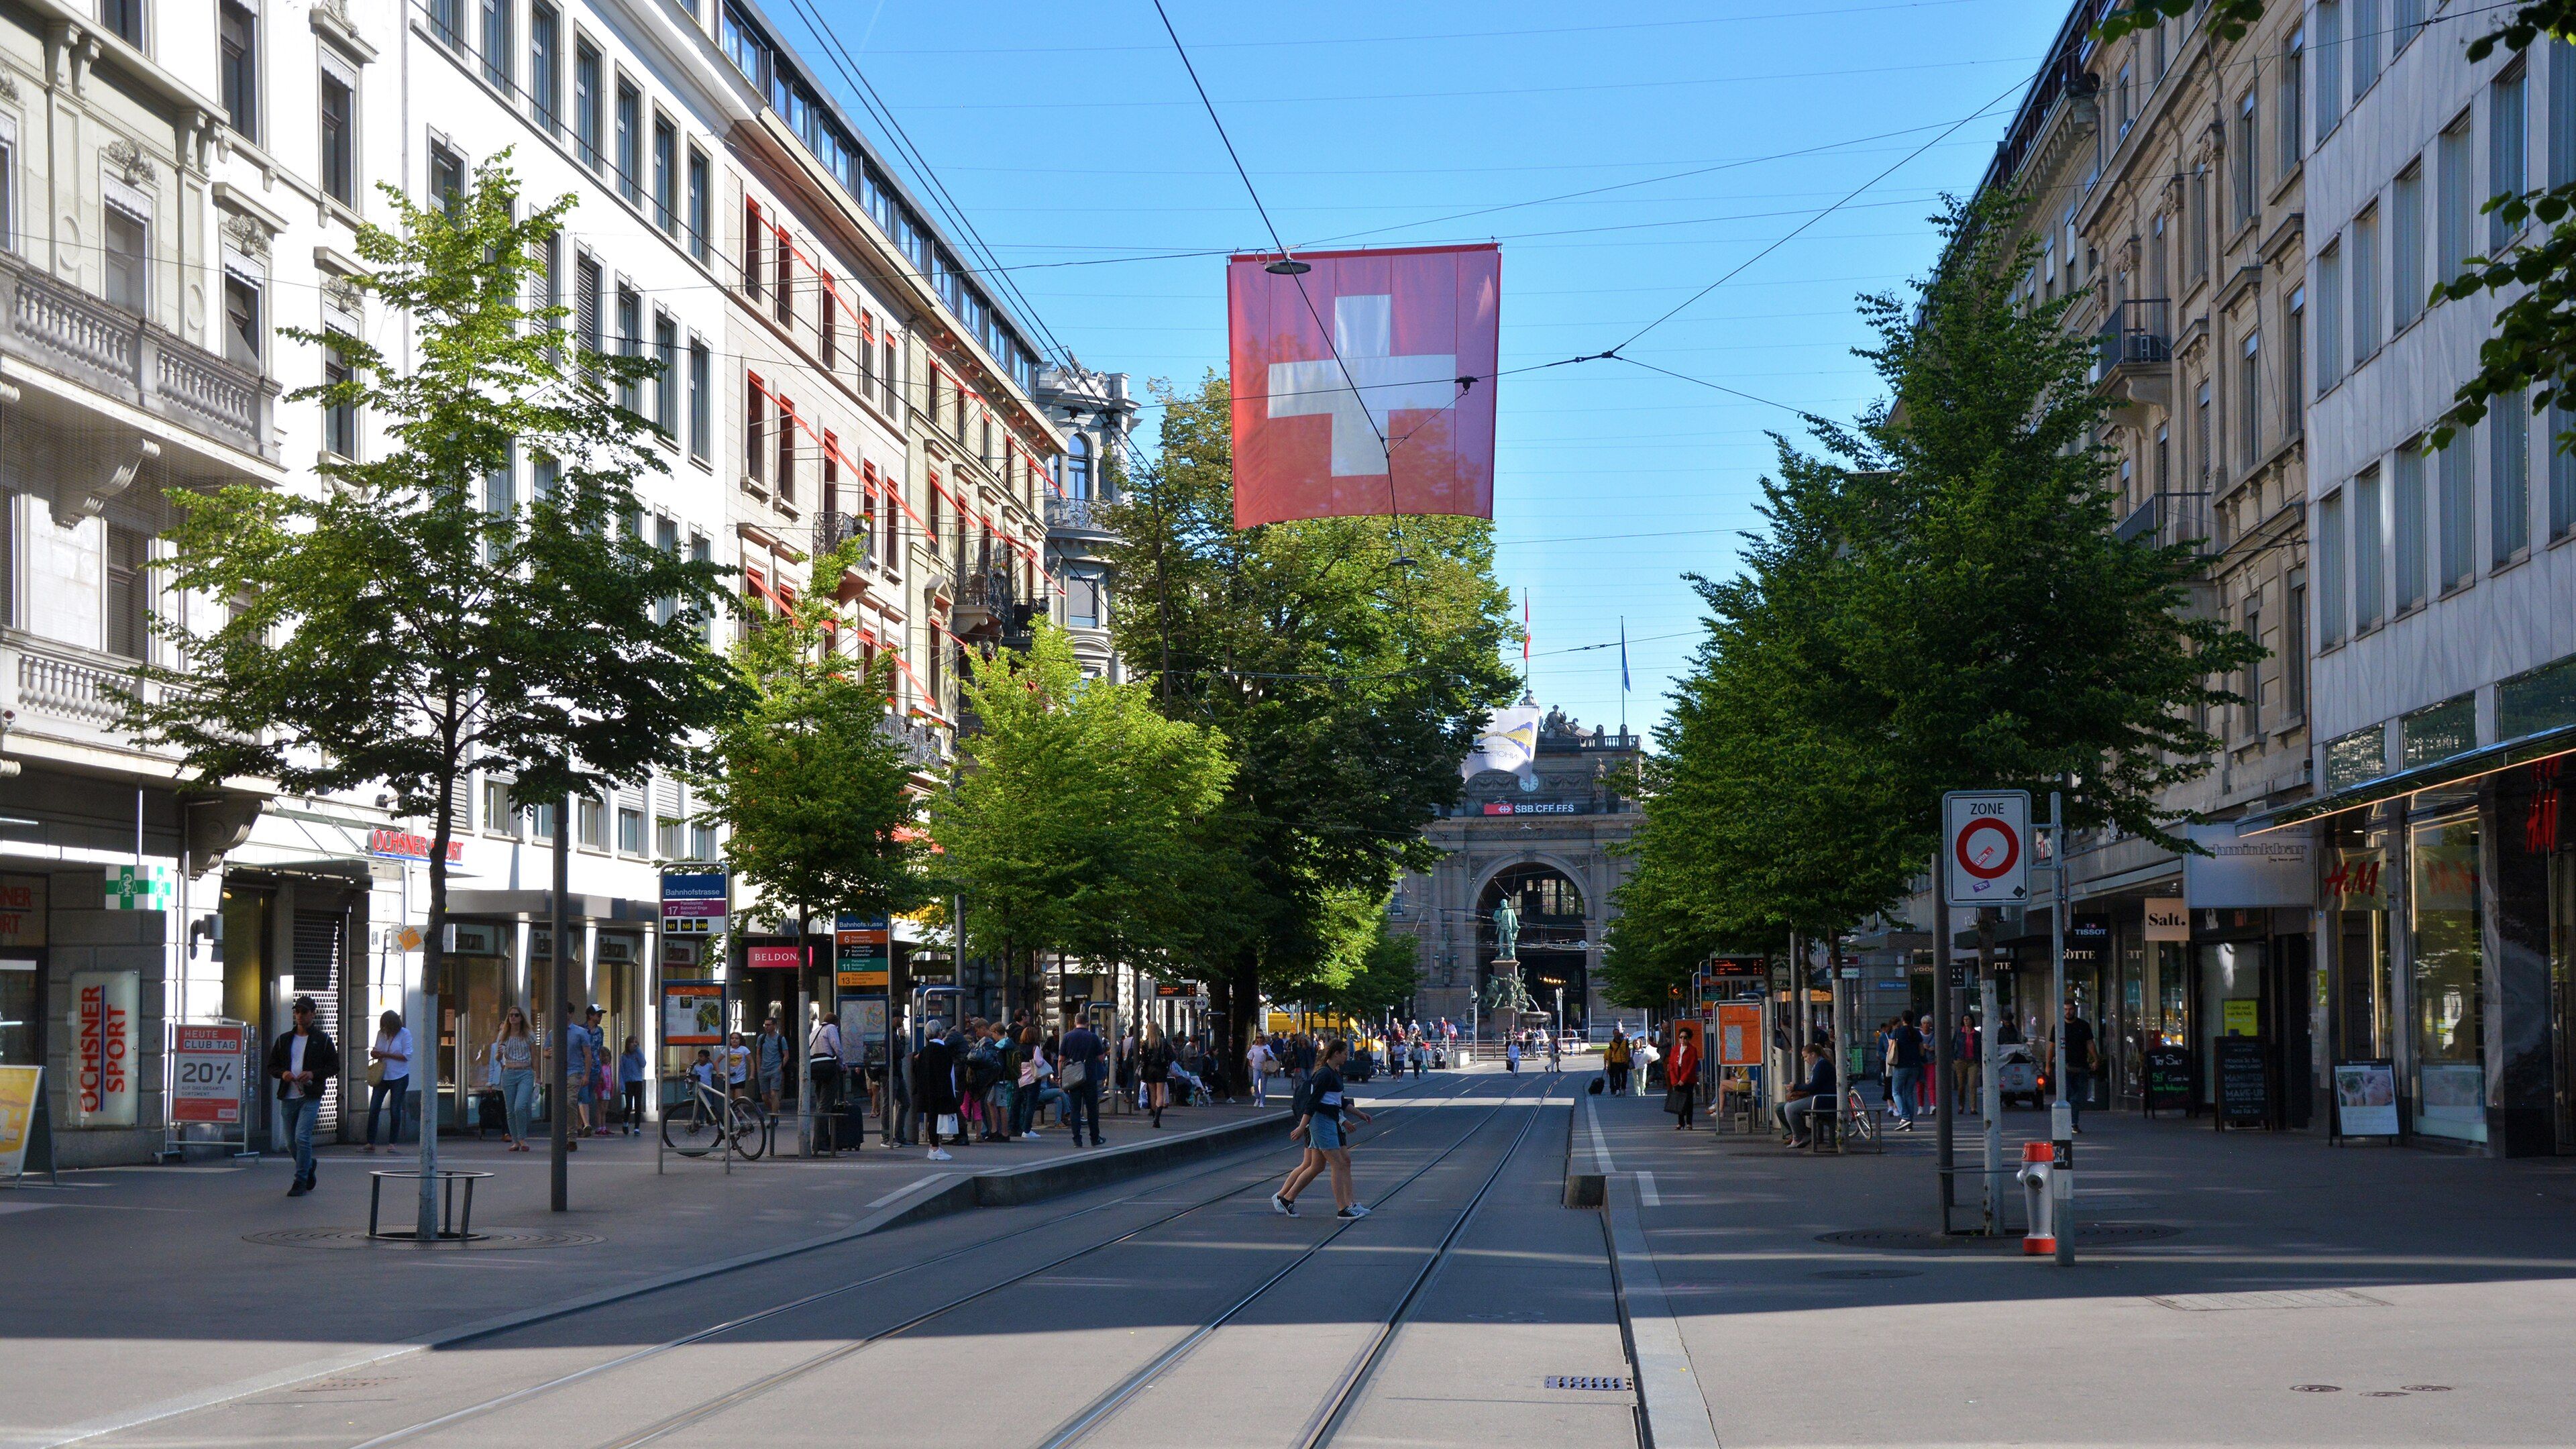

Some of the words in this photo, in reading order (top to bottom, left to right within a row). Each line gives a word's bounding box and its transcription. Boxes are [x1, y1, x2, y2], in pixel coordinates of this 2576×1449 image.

[1515, 804, 1534, 813] SBB
[1536, 804, 1554, 812] CFF
[1556, 804, 1574, 812] FFS
[1970, 803, 2004, 815] ZONE
[372, 828, 427, 855] OCHSNER
[430, 838, 464, 861] SORT
[2194, 843, 2306, 855] chminkbar
[2323, 861, 2380, 897] H&M
[667, 906, 678, 915] 17
[2148, 912, 2186, 926] Salt.
[844, 935, 850, 943] 6
[755, 953, 801, 961] BELDON
[845, 949, 850, 957] 7
[184, 1030, 219, 1038] HEUTE
[79, 985, 101, 1114] OCHSNER
[106, 1004, 126, 1093] SPORT
[184, 1040, 212, 1049] CLUB
[217, 1041, 235, 1049] TAG
[182, 1062, 232, 1085] 20%
